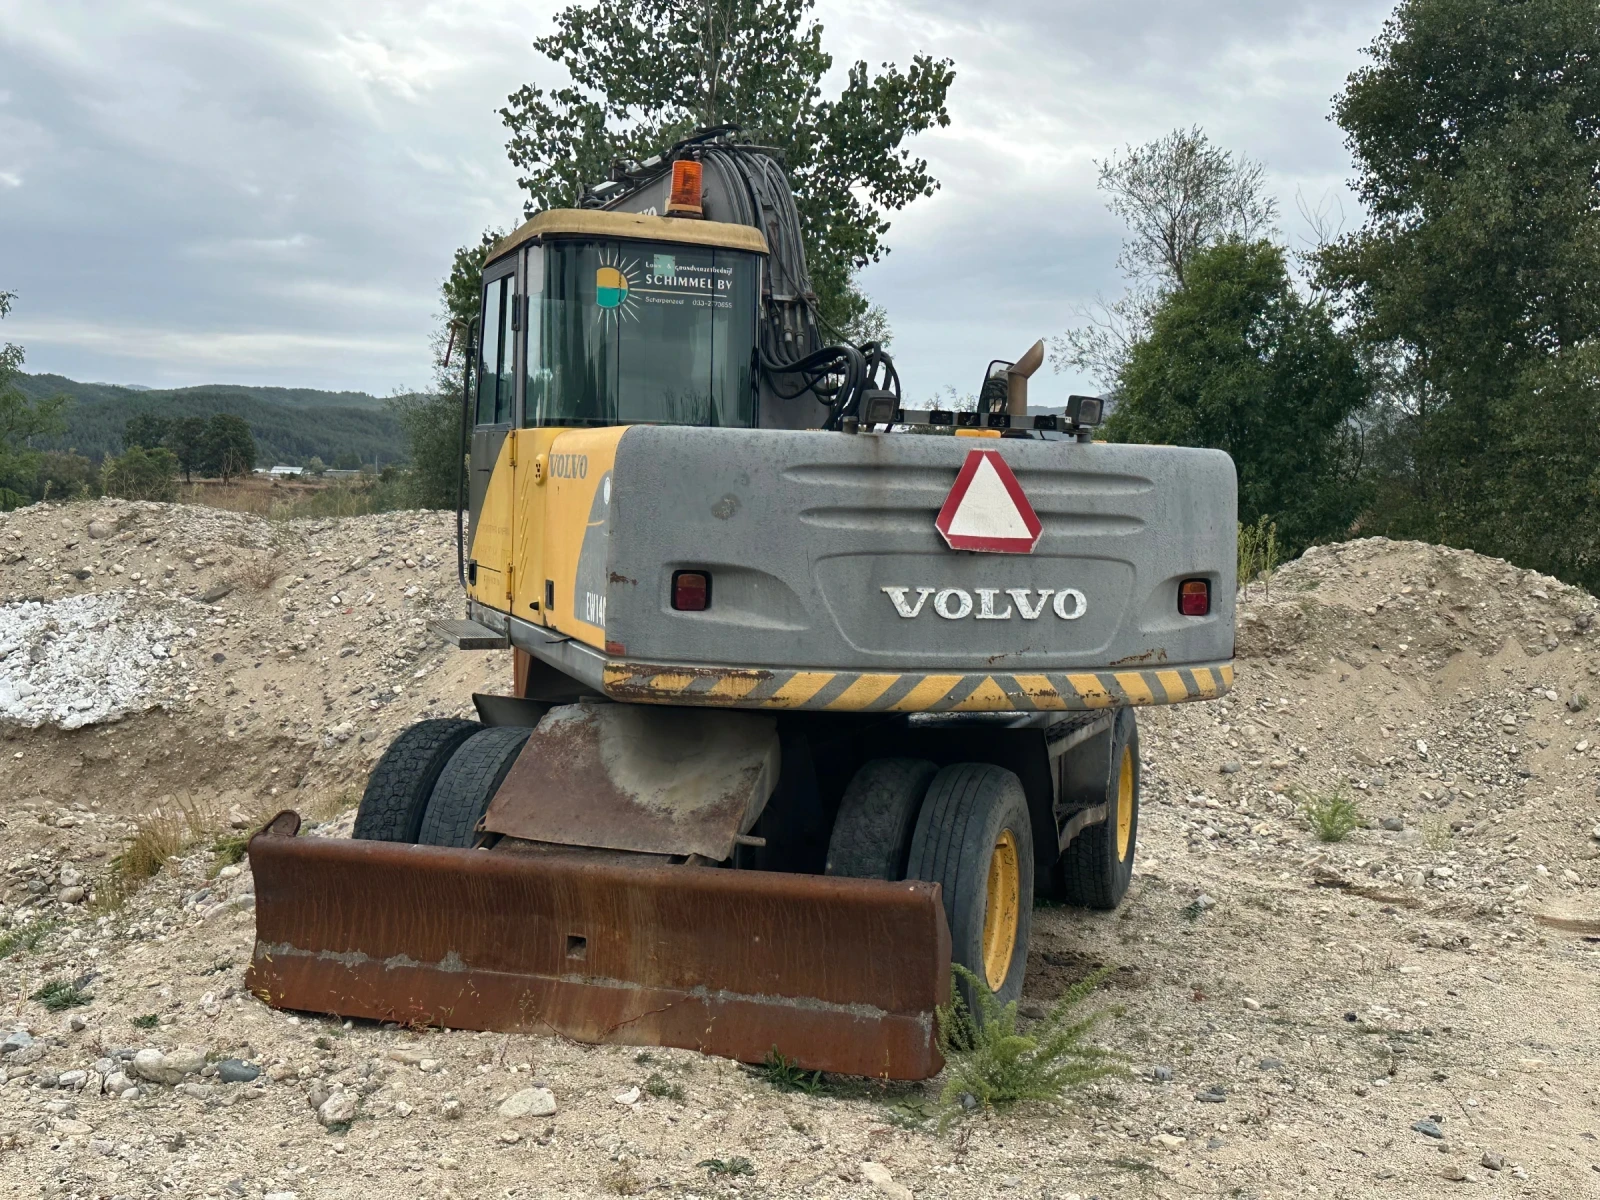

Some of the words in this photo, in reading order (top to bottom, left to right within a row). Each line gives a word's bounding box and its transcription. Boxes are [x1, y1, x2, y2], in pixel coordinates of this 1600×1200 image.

[645, 273, 713, 289] SCHIMMEL
[549, 454, 588, 479] VOLVO
[880, 585, 1088, 620] VOLVO
